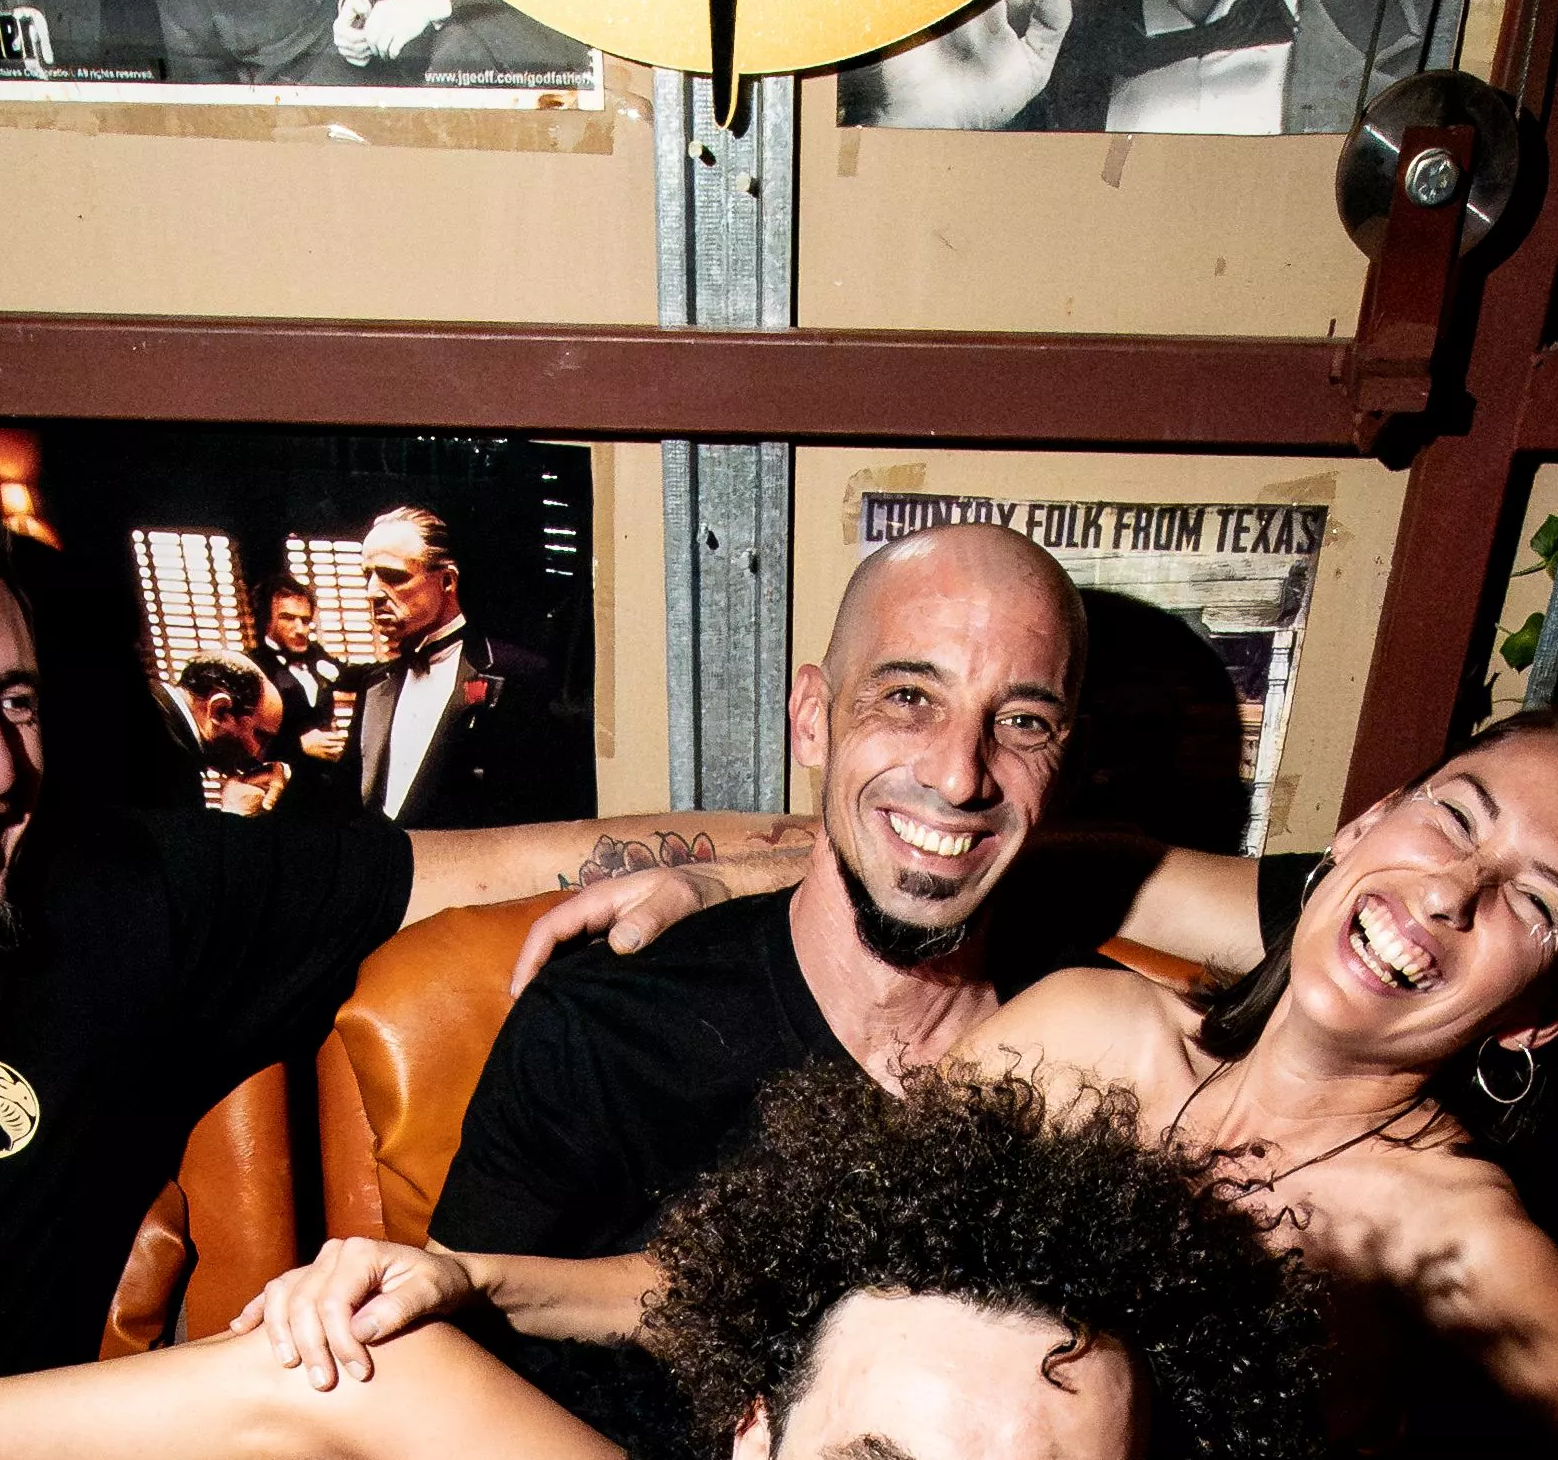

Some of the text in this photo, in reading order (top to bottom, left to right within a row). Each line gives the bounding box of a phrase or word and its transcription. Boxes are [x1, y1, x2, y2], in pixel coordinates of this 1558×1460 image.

[866, 498, 1323, 555] COUNTRY FOLK FROM TEXAS
